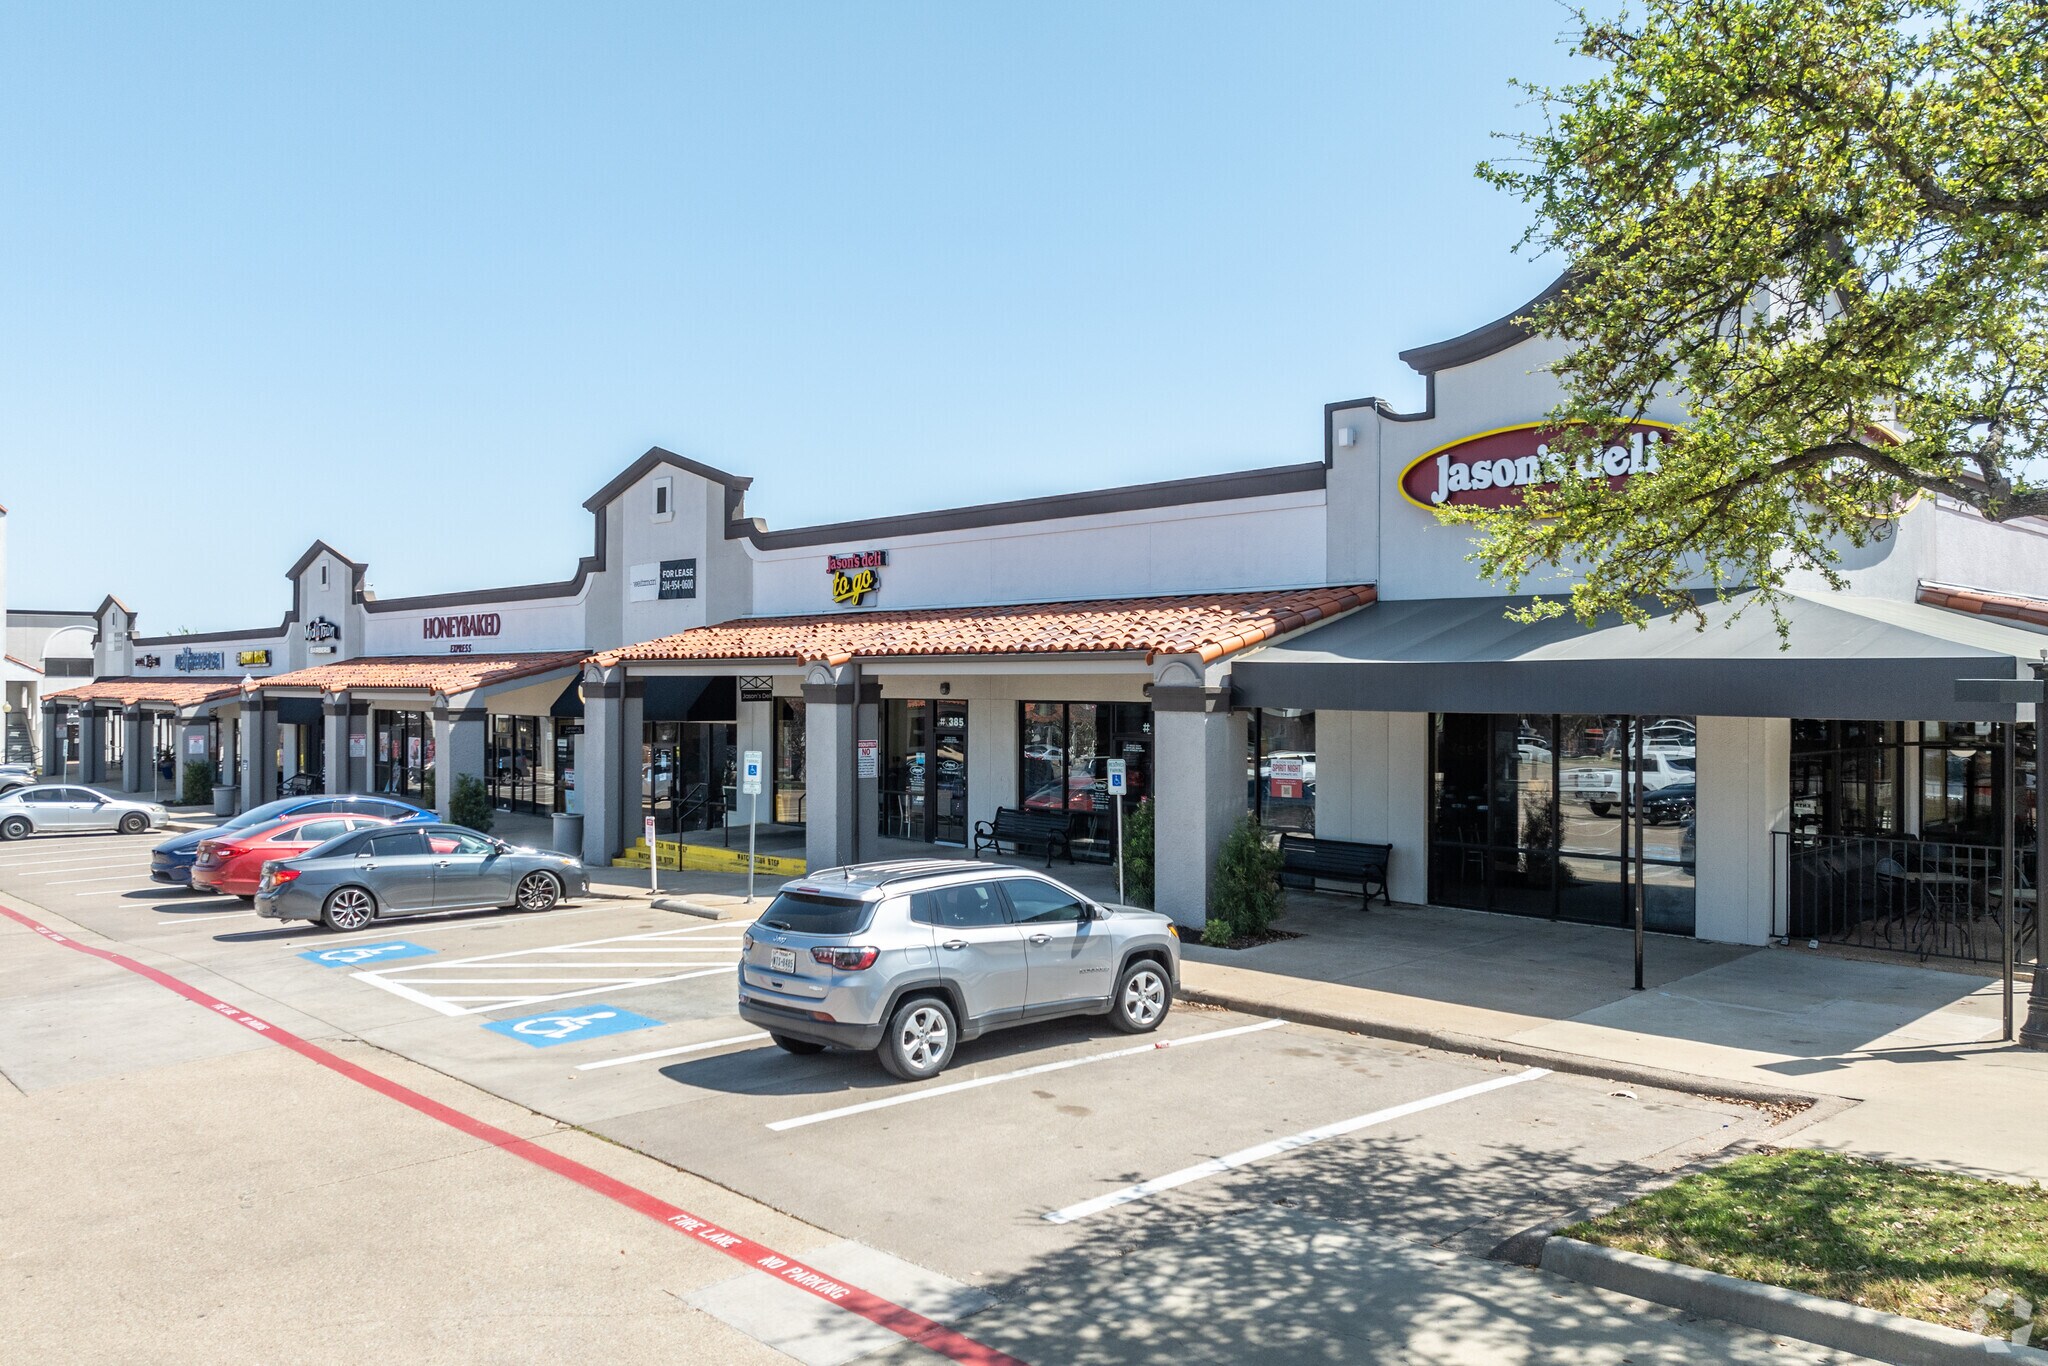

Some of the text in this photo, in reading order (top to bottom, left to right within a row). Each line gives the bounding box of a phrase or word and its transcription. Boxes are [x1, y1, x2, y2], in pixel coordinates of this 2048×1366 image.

[861, 550, 882, 567] deli
[662, 568, 694, 578] FOR LEASE
[833, 569, 873, 606] to go
[423, 613, 501, 639] HONEYBAKED
[450, 644, 472, 653] EXPRESS
[948, 717, 964, 726] 385
[861, 748, 871, 756] NO
[1287, 764, 1301, 773] NIGHT
[737, 854, 750, 862] WATC
[667, 1214, 851, 1300] FIRE LANE NO PARKING
